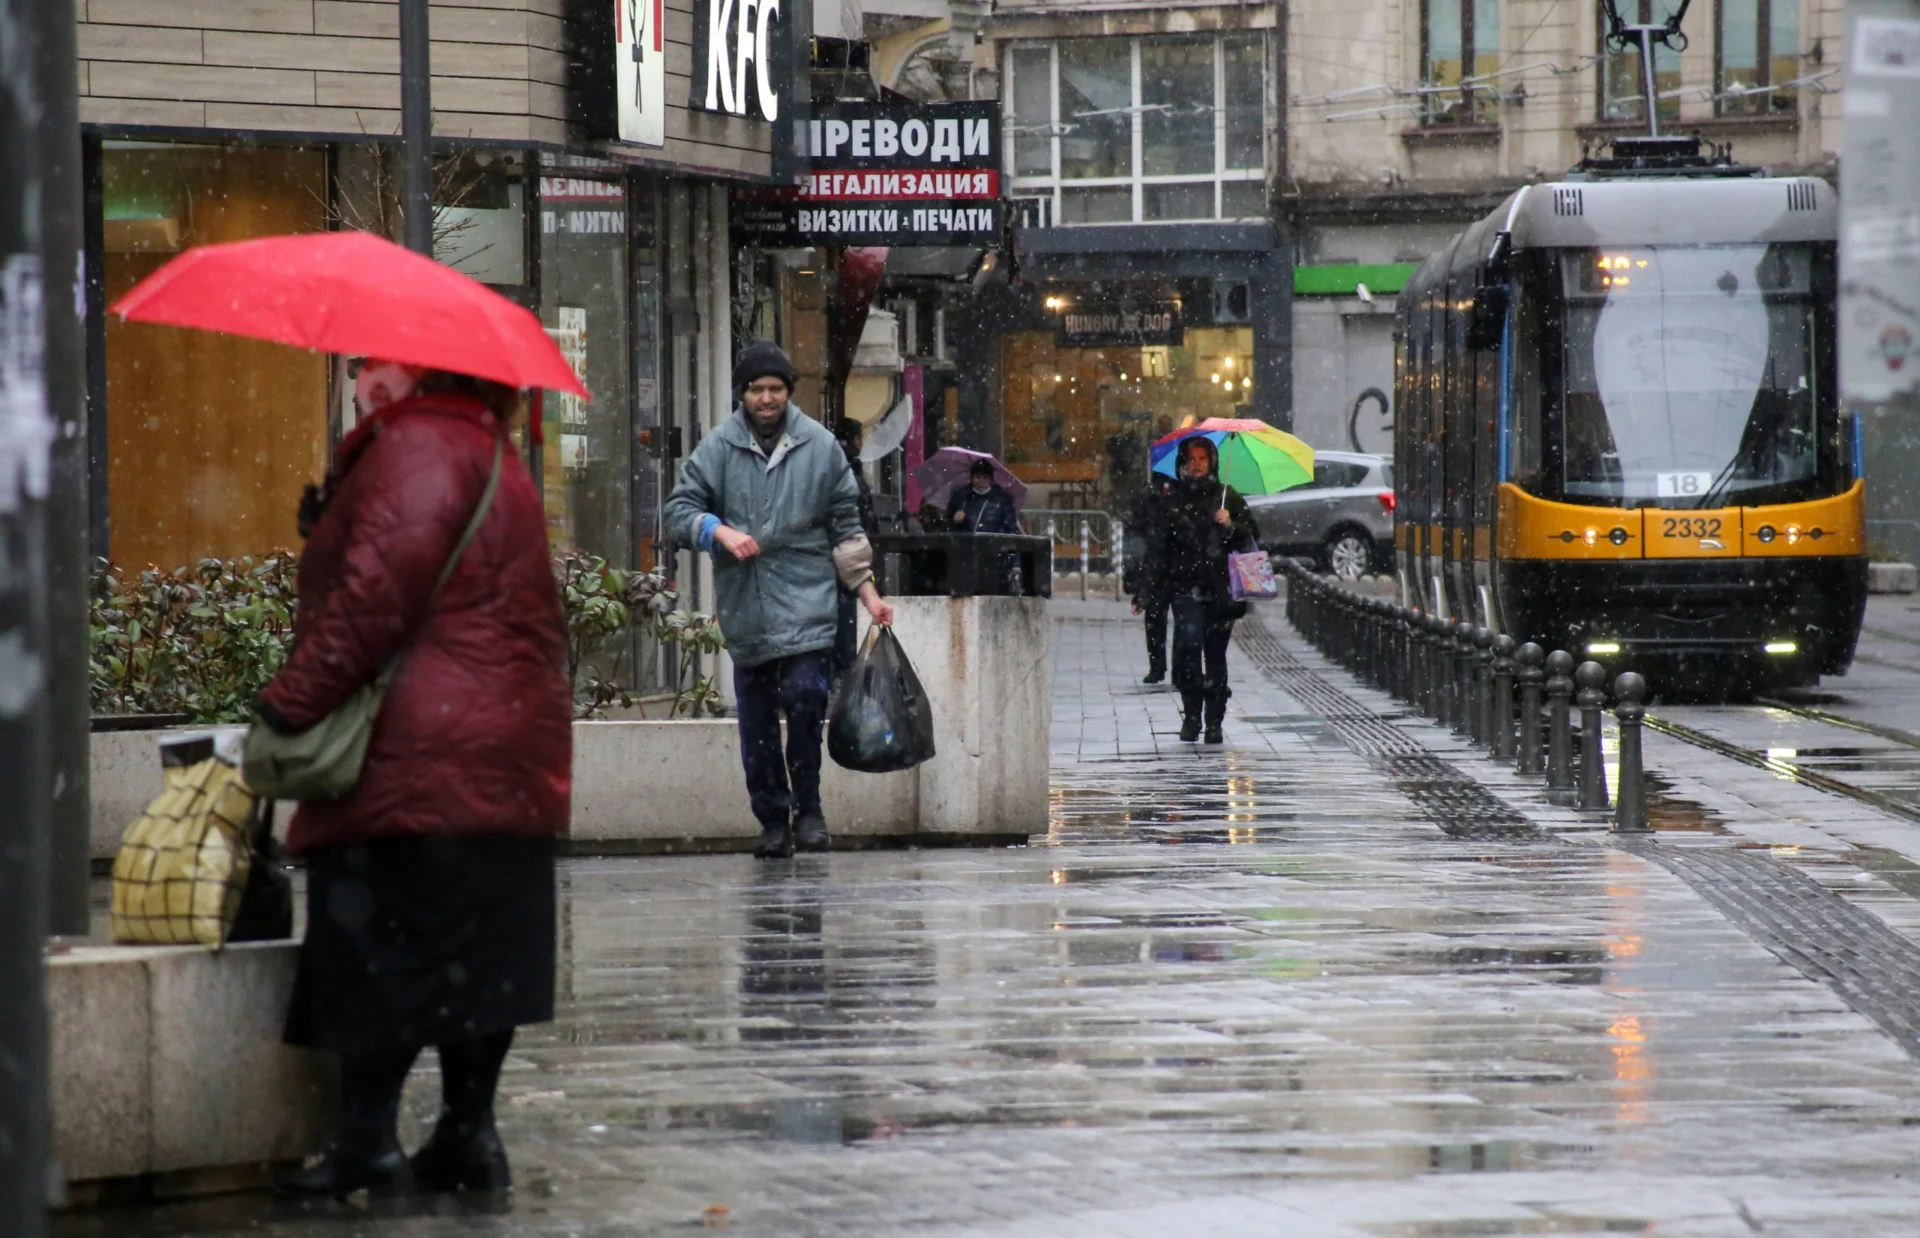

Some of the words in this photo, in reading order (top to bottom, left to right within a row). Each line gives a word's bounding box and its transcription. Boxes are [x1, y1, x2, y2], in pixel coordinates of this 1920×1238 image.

[705, 0, 779, 122] KFC
[798, 173, 989, 198] ЛЕГАЛИЗАЦИЯ
[798, 209, 898, 232] ВИЗИТКИ
[914, 208, 993, 231] ПЕЧАТИ
[1065, 314, 1118, 333] HUNGRY
[1144, 313, 1172, 332] DOG
[1667, 474, 1699, 494] 18
[1663, 517, 1722, 538] 2332
